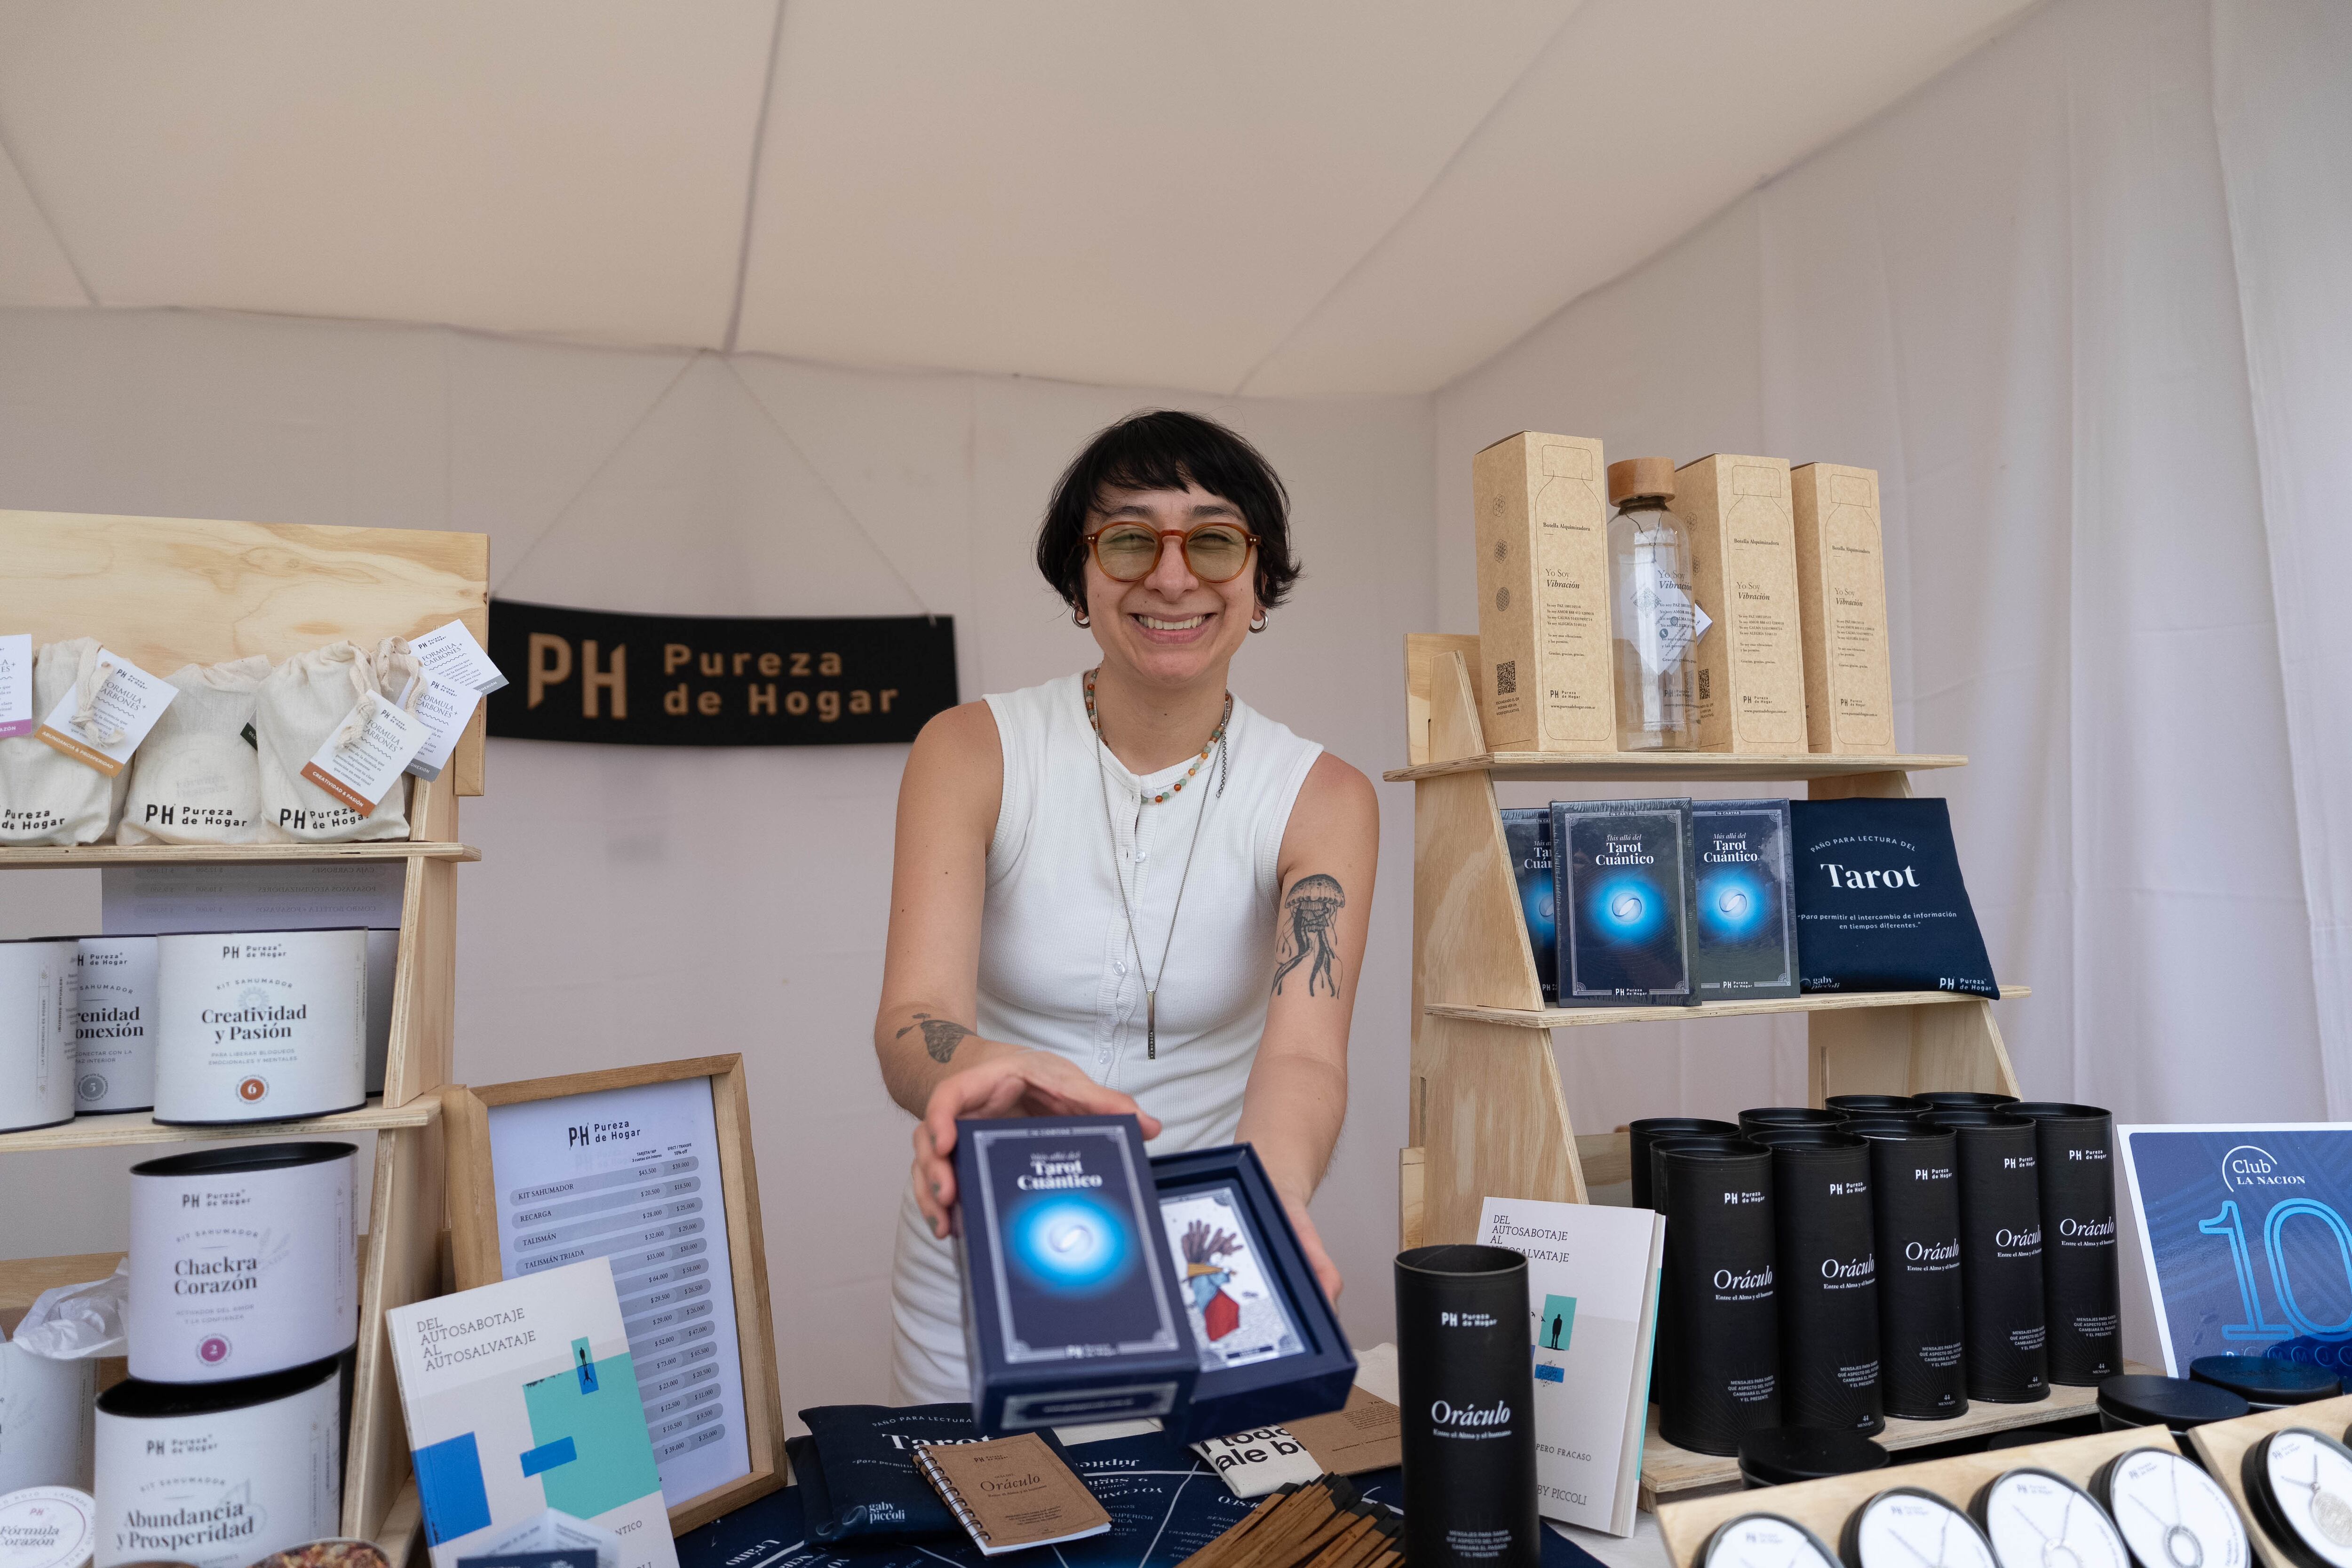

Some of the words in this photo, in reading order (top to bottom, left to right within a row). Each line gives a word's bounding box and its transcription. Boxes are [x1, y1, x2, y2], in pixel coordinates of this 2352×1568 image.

[1545, 568, 1556, 577] Yo
[1557, 569, 1570, 579] Soy
[1658, 570, 1670, 578] Yo
[1673, 570, 1685, 581] Soy
[1547, 580, 1580, 589] Vibración
[1748, 582, 1760, 591] Soy
[1738, 592, 1770, 601] Vibración
[1836, 597, 1863, 607] Vibración
[421, 642, 456, 661] FORMULA
[424, 647, 461, 667] CARBONES
[664, 643, 842, 677] Pureza
[527, 632, 628, 720] PH
[421, 693, 453, 711] FORMULA
[664, 683, 722, 716] de
[748, 684, 899, 722] Hogar
[1743, 695, 1752, 704] PH
[381, 709, 390, 719] PH
[367, 719, 400, 744] FORMULA
[41, 731, 75, 751] ABUNDANCIA
[80, 750, 113, 769] PROSPERIDAD
[312, 772, 342, 793] CREATIVIDAD
[346, 793, 363, 807] PASIÓN
[5, 809, 50, 818] Pureza
[144, 804, 174, 825] PH
[183, 806, 233, 816] Pureza
[310, 807, 356, 819] Pureza
[2, 821, 15, 830] de
[22, 817, 65, 829] Hogar
[204, 817, 247, 827] Hogar
[280, 808, 305, 829] PH
[332, 813, 368, 828] Hoga
[1606, 841, 1642, 853] Tarot
[1713, 840, 1747, 851] Tarot
[1811, 840, 1831, 853] PAÑO
[1859, 836, 1897, 844] LECTURA
[1901, 841, 1915, 852] DEL
[1596, 853, 1654, 866] Cuántico
[1703, 851, 1758, 863] Cuántico
[1820, 864, 1920, 889] Tarot
[223, 946, 240, 959] PH
[235, 979, 293, 988] SAHUMADOR
[1813, 976, 1833, 985] gaby
[1939, 978, 1955, 990] PH
[79, 984, 134, 994] SAHUMADOR
[1615, 988, 1624, 996] PH
[202, 1004, 307, 1024] Creatividad
[215, 1029, 224, 1043] y
[230, 1024, 292, 1040] Pasión
[90, 1082, 96, 1092] 5
[595, 1120, 630, 1132] Pureza
[568, 1123, 590, 1149] PH
[595, 1134, 607, 1142] de
[612, 1129, 641, 1141] Hogar
[2069, 1150, 2082, 1161] PH
[1032, 1161, 1083, 1176] Tarot
[2233, 1159, 2271, 1173] Club
[1915, 1169, 1928, 1180] PH
[2237, 1176, 2254, 1185] LA
[532, 1184, 574, 1197] SAHUMADOR
[639, 1167, 657, 1176] $43.500
[1017, 1174, 1103, 1191] Cuántico
[1830, 1184, 1842, 1195] PH
[183, 1194, 199, 1208] PH
[520, 1210, 552, 1222] RECARGA
[675, 1182, 691, 1190] $18.500
[1724, 1192, 1738, 1204] PH
[1494, 1215, 1510, 1225] DEL
[2060, 1217, 2114, 1236] Oráculo
[523, 1233, 556, 1246] TALISMÁN
[1490, 1235, 1502, 1244] AL
[1492, 1225, 1568, 1241] AUTOSABOTAJE
[1995, 1225, 2041, 1247] Oráculo
[647, 1251, 665, 1260] $33.000
[680, 1243, 698, 1252] $30.000
[1906, 1239, 1959, 1260] Oráculo
[175, 1257, 258, 1276] Chackra
[524, 1256, 558, 1269] TALISMÁN
[560, 1250, 584, 1262] TRIADA
[1822, 1254, 1874, 1278] Oráculo
[2199, 1198, 2352, 1341] 10
[175, 1274, 258, 1295] Corazón
[1714, 1266, 1773, 1289] Oráculo
[417, 1317, 443, 1332] DEL
[421, 1308, 525, 1345] AUTOSABOTAJE
[1441, 1313, 1458, 1327] PH
[423, 1347, 442, 1358] AL
[425, 1330, 536, 1371] AUTOSALVATAJE
[1431, 1401, 1510, 1426] Oráculo
[873, 1418, 896, 1427] PAÑO
[1536, 1444, 1555, 1453] PERO
[1557, 1448, 1591, 1461] FRACASO
[980, 1474, 1040, 1491] Oráculo
[1552, 1488, 1587, 1505] PICCOLI
[869, 1502, 894, 1512] gaby
[124, 1502, 245, 1528] Abundancia
[869, 1510, 905, 1524] piccoli
[0, 1524, 59, 1537] Fórmula
[129, 1516, 254, 1551] Prosperidad
